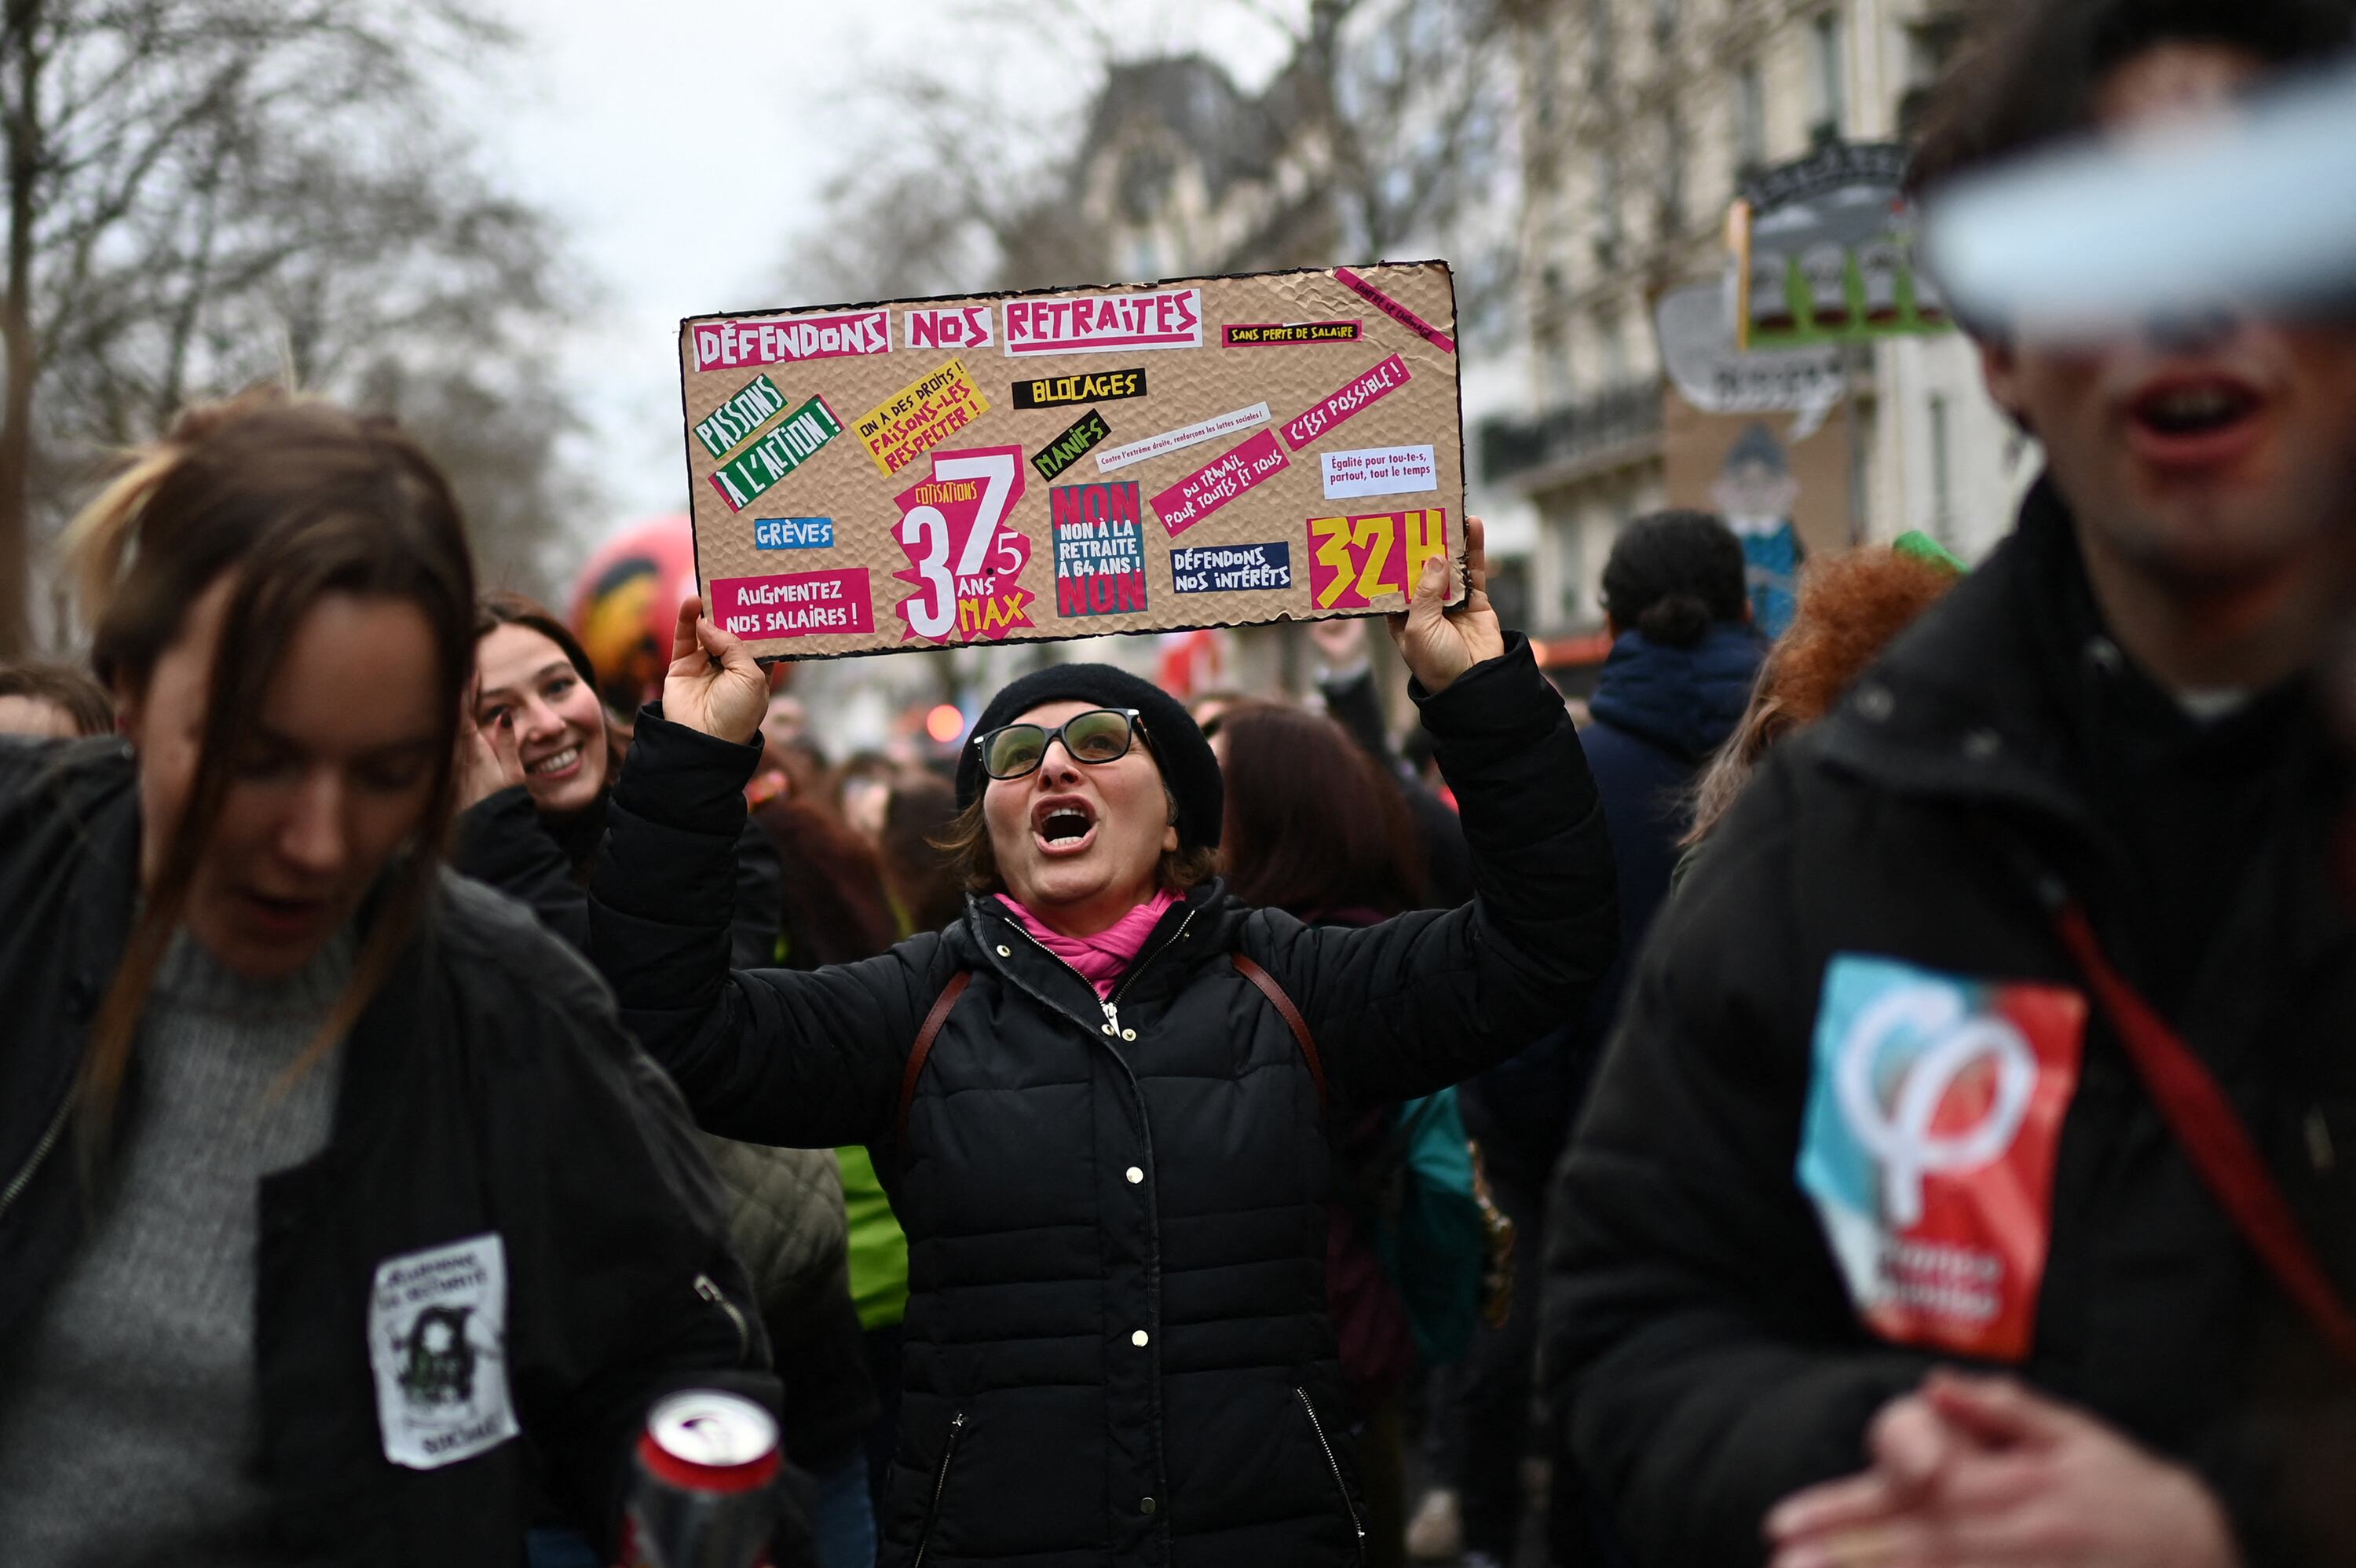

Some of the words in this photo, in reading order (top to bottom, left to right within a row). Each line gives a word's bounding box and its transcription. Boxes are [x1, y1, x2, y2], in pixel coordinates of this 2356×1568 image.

[1354, 281, 1385, 306] CONTRE
[1385, 302, 1396, 313] LE
[912, 305, 989, 349] NOS
[1231, 328, 1259, 342] SANS
[1262, 327, 1293, 341] PERTE
[1296, 327, 1308, 339] DE
[1031, 373, 1138, 404] BLOCAGES
[696, 375, 783, 455] PASSONS
[859, 419, 880, 438] ON
[880, 411, 891, 426] A
[891, 395, 914, 417] DES
[1290, 408, 1327, 440] C'EST
[884, 405, 969, 474] RESPECTER
[1101, 454, 1121, 465] Contre
[1152, 437, 1173, 451] droite,
[1173, 430, 1205, 444] renforçons
[1216, 419, 1235, 430] luttes
[1330, 470, 1367, 485] partout,
[1370, 468, 1388, 478] tout
[1392, 466, 1400, 477] le
[1403, 466, 1430, 477] temps
[1331, 455, 1363, 471] Égalité
[1365, 456, 1385, 469] pour
[1164, 501, 1197, 528] POUR
[1197, 477, 1238, 509] TOUTES
[1237, 467, 1252, 488] ET
[1253, 449, 1282, 474] TOUS
[1183, 481, 1200, 498] DU
[1052, 483, 1140, 530] NON
[756, 519, 832, 546] GRÈVES
[1060, 521, 1094, 541] NON
[1098, 517, 1109, 538] À
[1113, 519, 1135, 537] LA
[1059, 538, 1138, 559] RETRAITE
[1174, 546, 1266, 570] DÉFENDONS
[1311, 508, 1447, 609] 32H
[1058, 557, 1070, 578] À
[1073, 560, 1095, 577] 64
[1099, 557, 1131, 576] ANS
[1176, 571, 1209, 590] NOS
[737, 580, 842, 606] AUGMENTEZ
[957, 576, 996, 598] ANS
[1058, 570, 1146, 616] NON
[726, 614, 760, 634] NOS
[958, 591, 1025, 632] MAX
